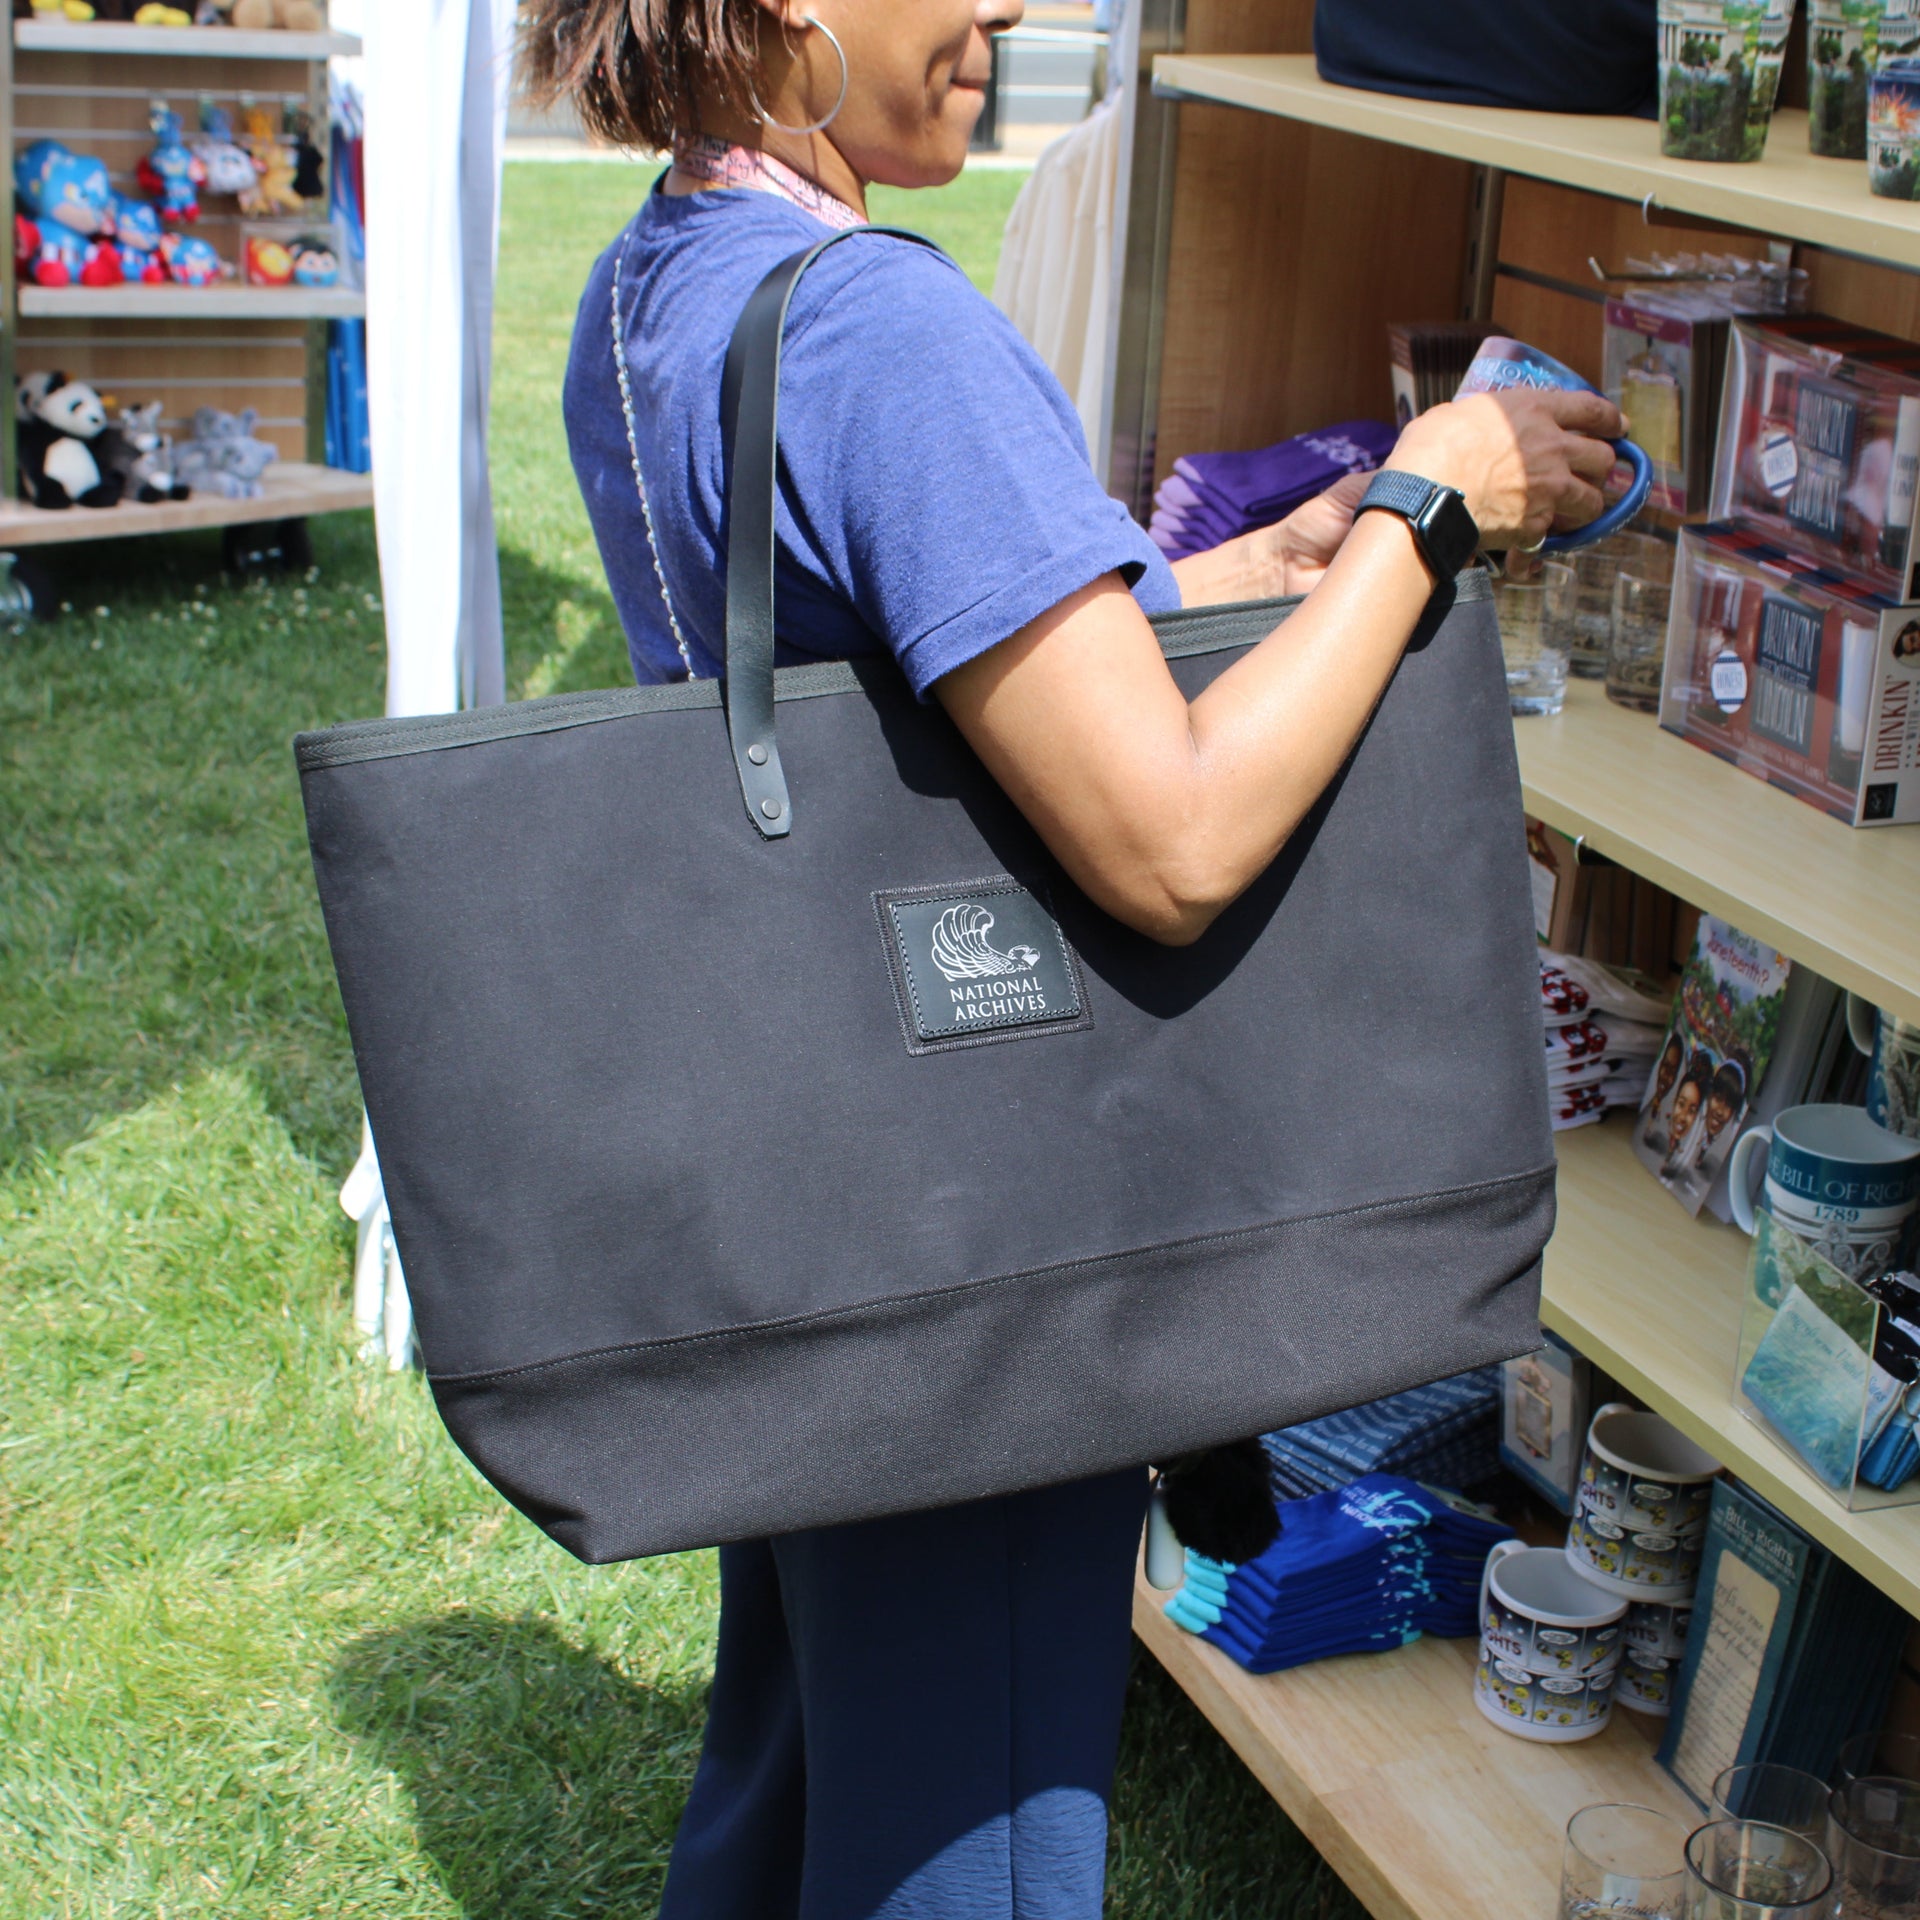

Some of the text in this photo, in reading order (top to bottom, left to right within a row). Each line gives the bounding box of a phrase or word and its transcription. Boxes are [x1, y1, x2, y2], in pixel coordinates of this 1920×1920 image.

[1873, 674, 1911, 771] DRINKIN'
[950, 977, 1043, 1003] NATIONAL
[954, 993, 1046, 1021] ARCHIVES
[1782, 1163, 1819, 1194] BILL
[1825, 1180, 1859, 1200] OF
[1814, 1205, 1861, 1224] 1789
